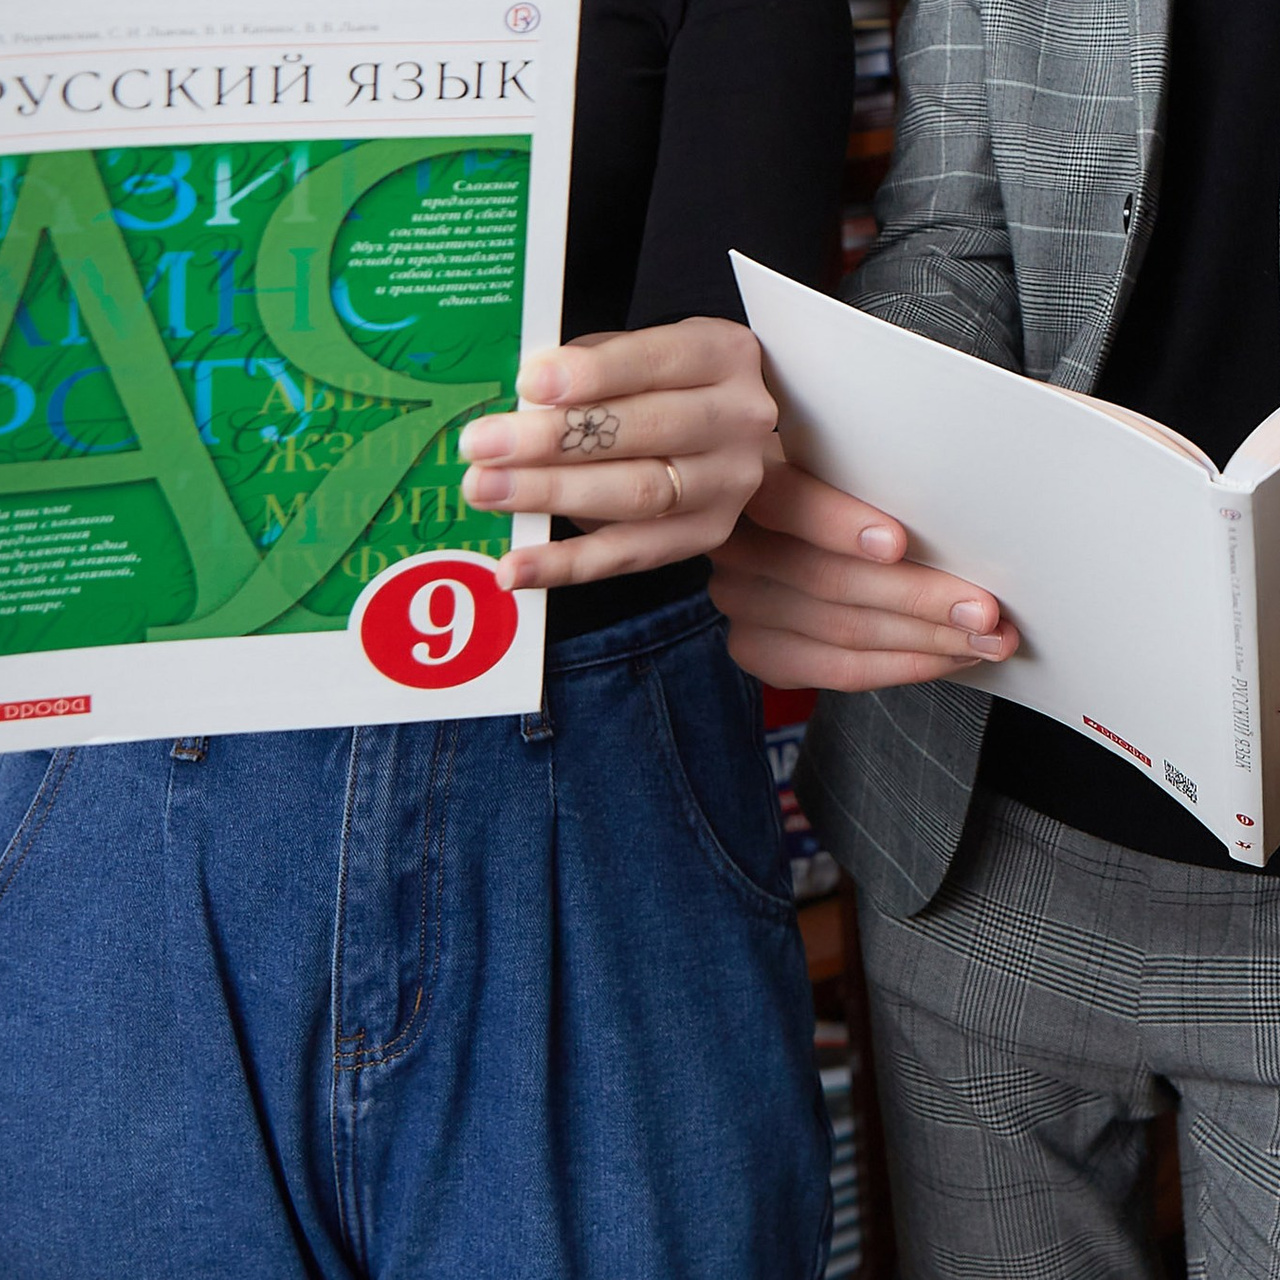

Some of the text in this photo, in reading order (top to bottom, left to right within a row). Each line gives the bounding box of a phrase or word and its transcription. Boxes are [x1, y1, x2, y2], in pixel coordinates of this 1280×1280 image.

[345, 58, 537, 107] ЯЗЫК
[408, 578, 476, 666] 9
[1231, 675, 1255, 737] РУССКИЙ
[1234, 734, 1252, 773] ЯЗЫК
